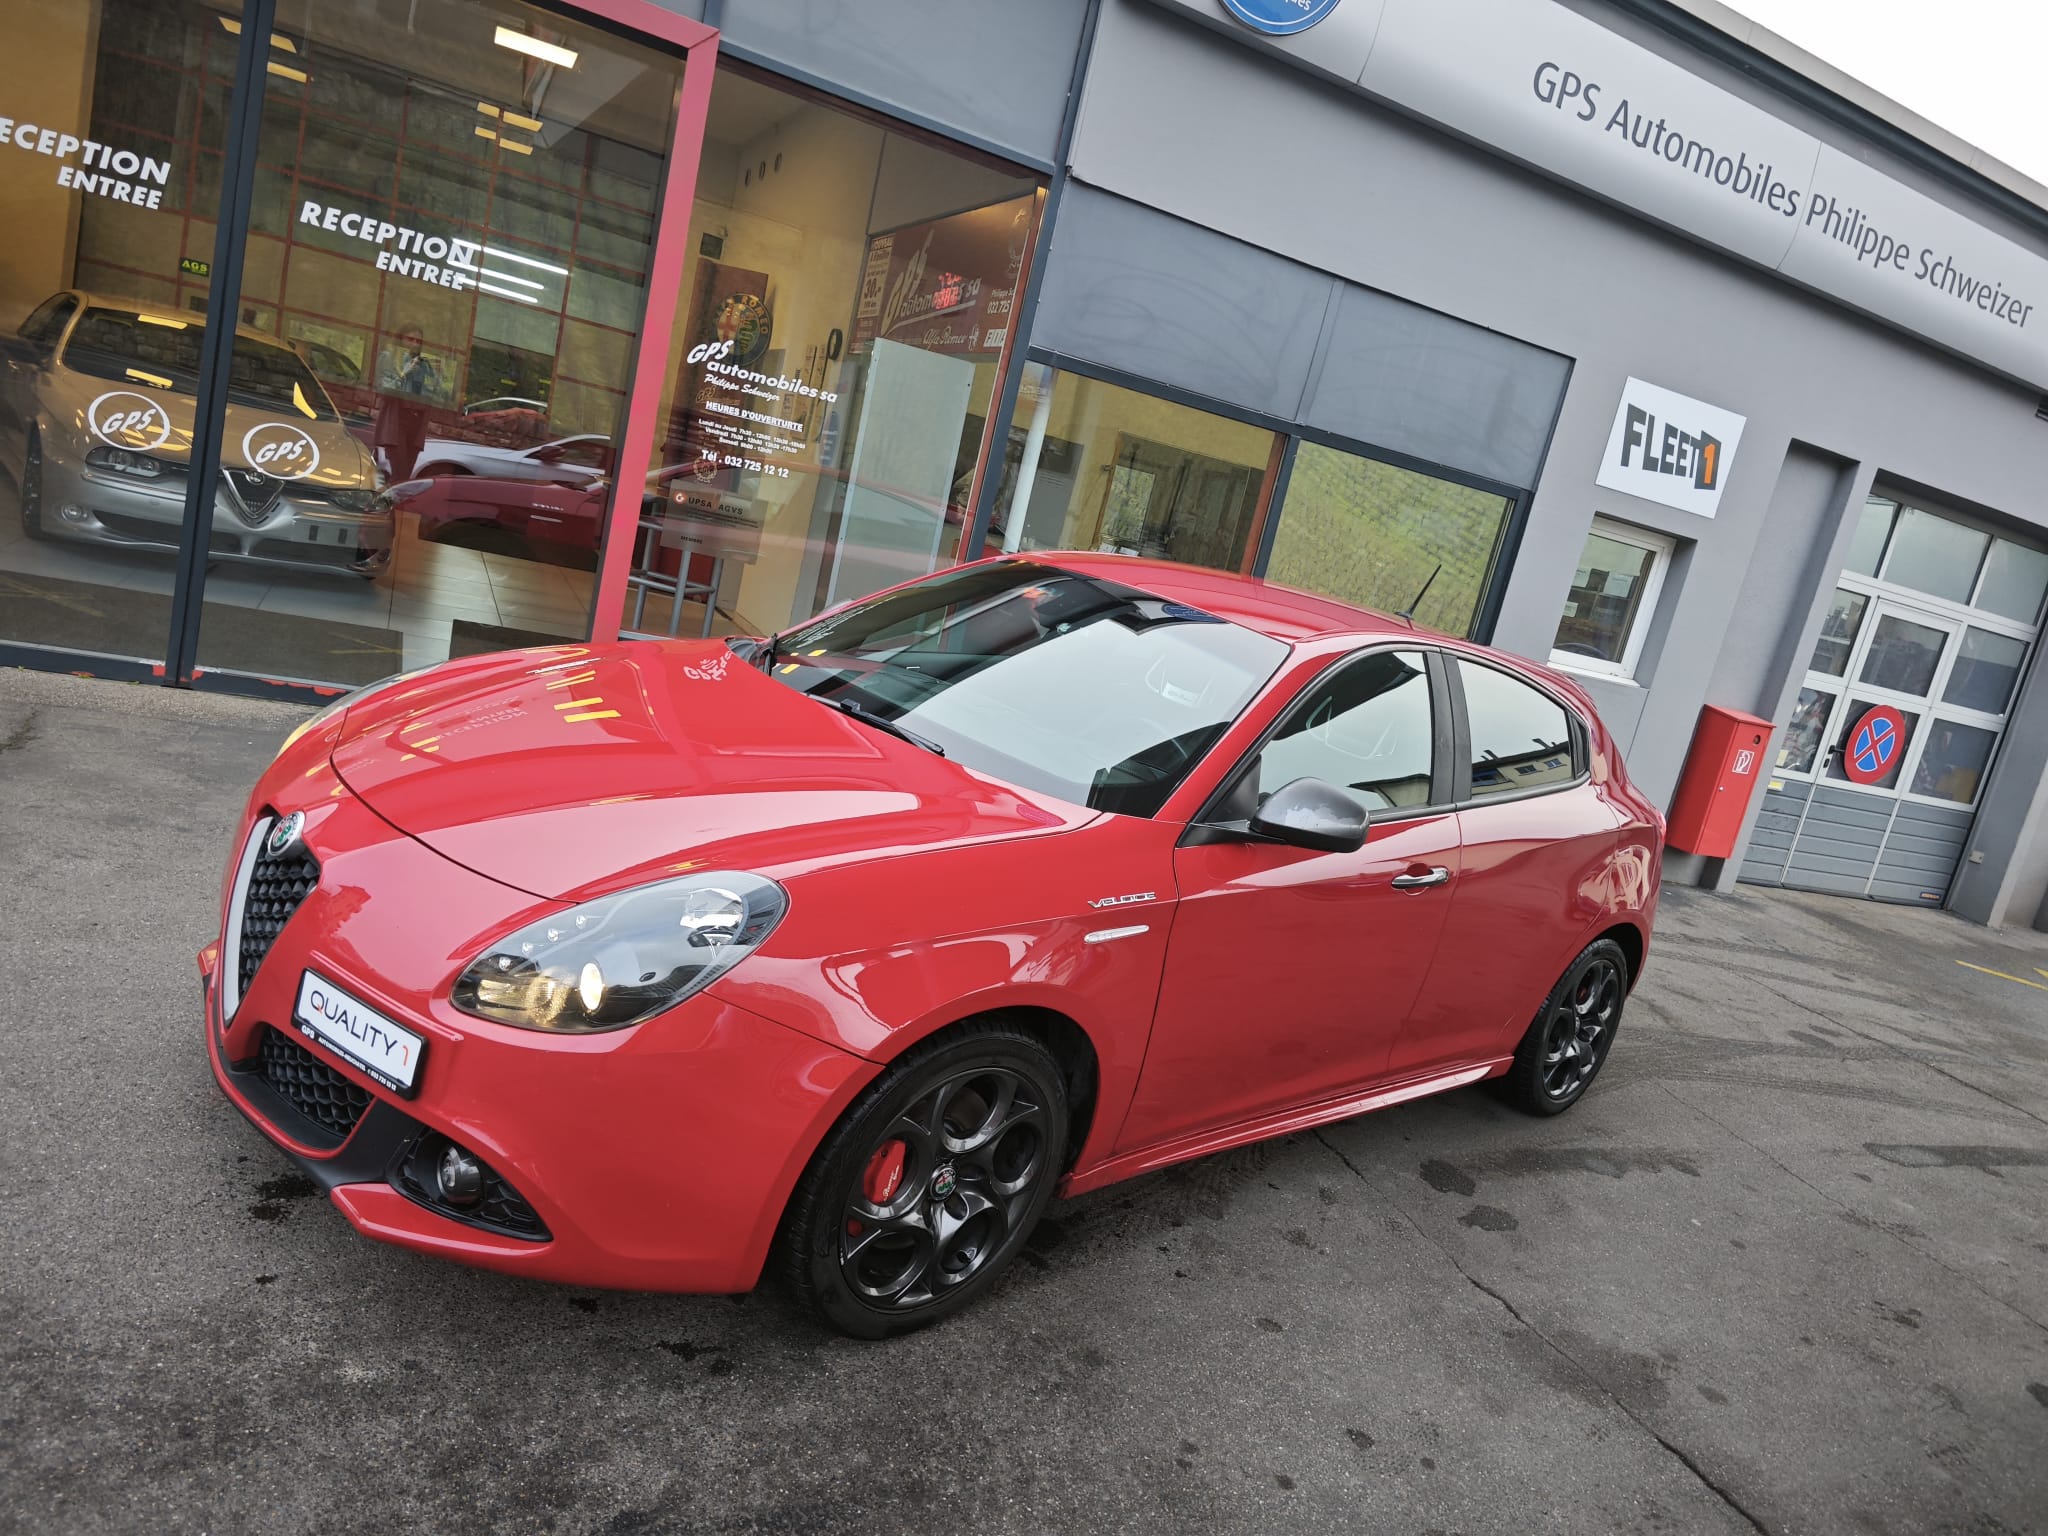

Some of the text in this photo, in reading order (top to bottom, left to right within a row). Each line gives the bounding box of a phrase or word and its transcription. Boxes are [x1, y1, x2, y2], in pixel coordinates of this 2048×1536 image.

[57, 166, 163, 210] ENTREE
[1533, 61, 2034, 328] GPS Automobiles Philippe Schweizer
[300, 200, 476, 266] RECEPTION
[375, 251, 467, 291] ENTREE
[687, 339, 734, 364] GPS
[704, 374, 739, 391] Philippe
[740, 384, 781, 402] Schweizer
[706, 360, 819, 398] automobiles
[819, 390, 838, 403] sa
[101, 408, 157, 434] GPS
[705, 401, 740, 417] HEURES
[741, 409, 804, 433] D'OUVERTURTE
[255, 439, 308, 464] GPS
[701, 449, 717, 462] Tél
[725, 455, 742, 468] 032
[744, 459, 761, 472] 725
[763, 463, 775, 476] 12
[777, 467, 789, 478] 12
[688, 497, 744, 515] UPSA AGVS
[310, 990, 398, 1056] QUALITY
